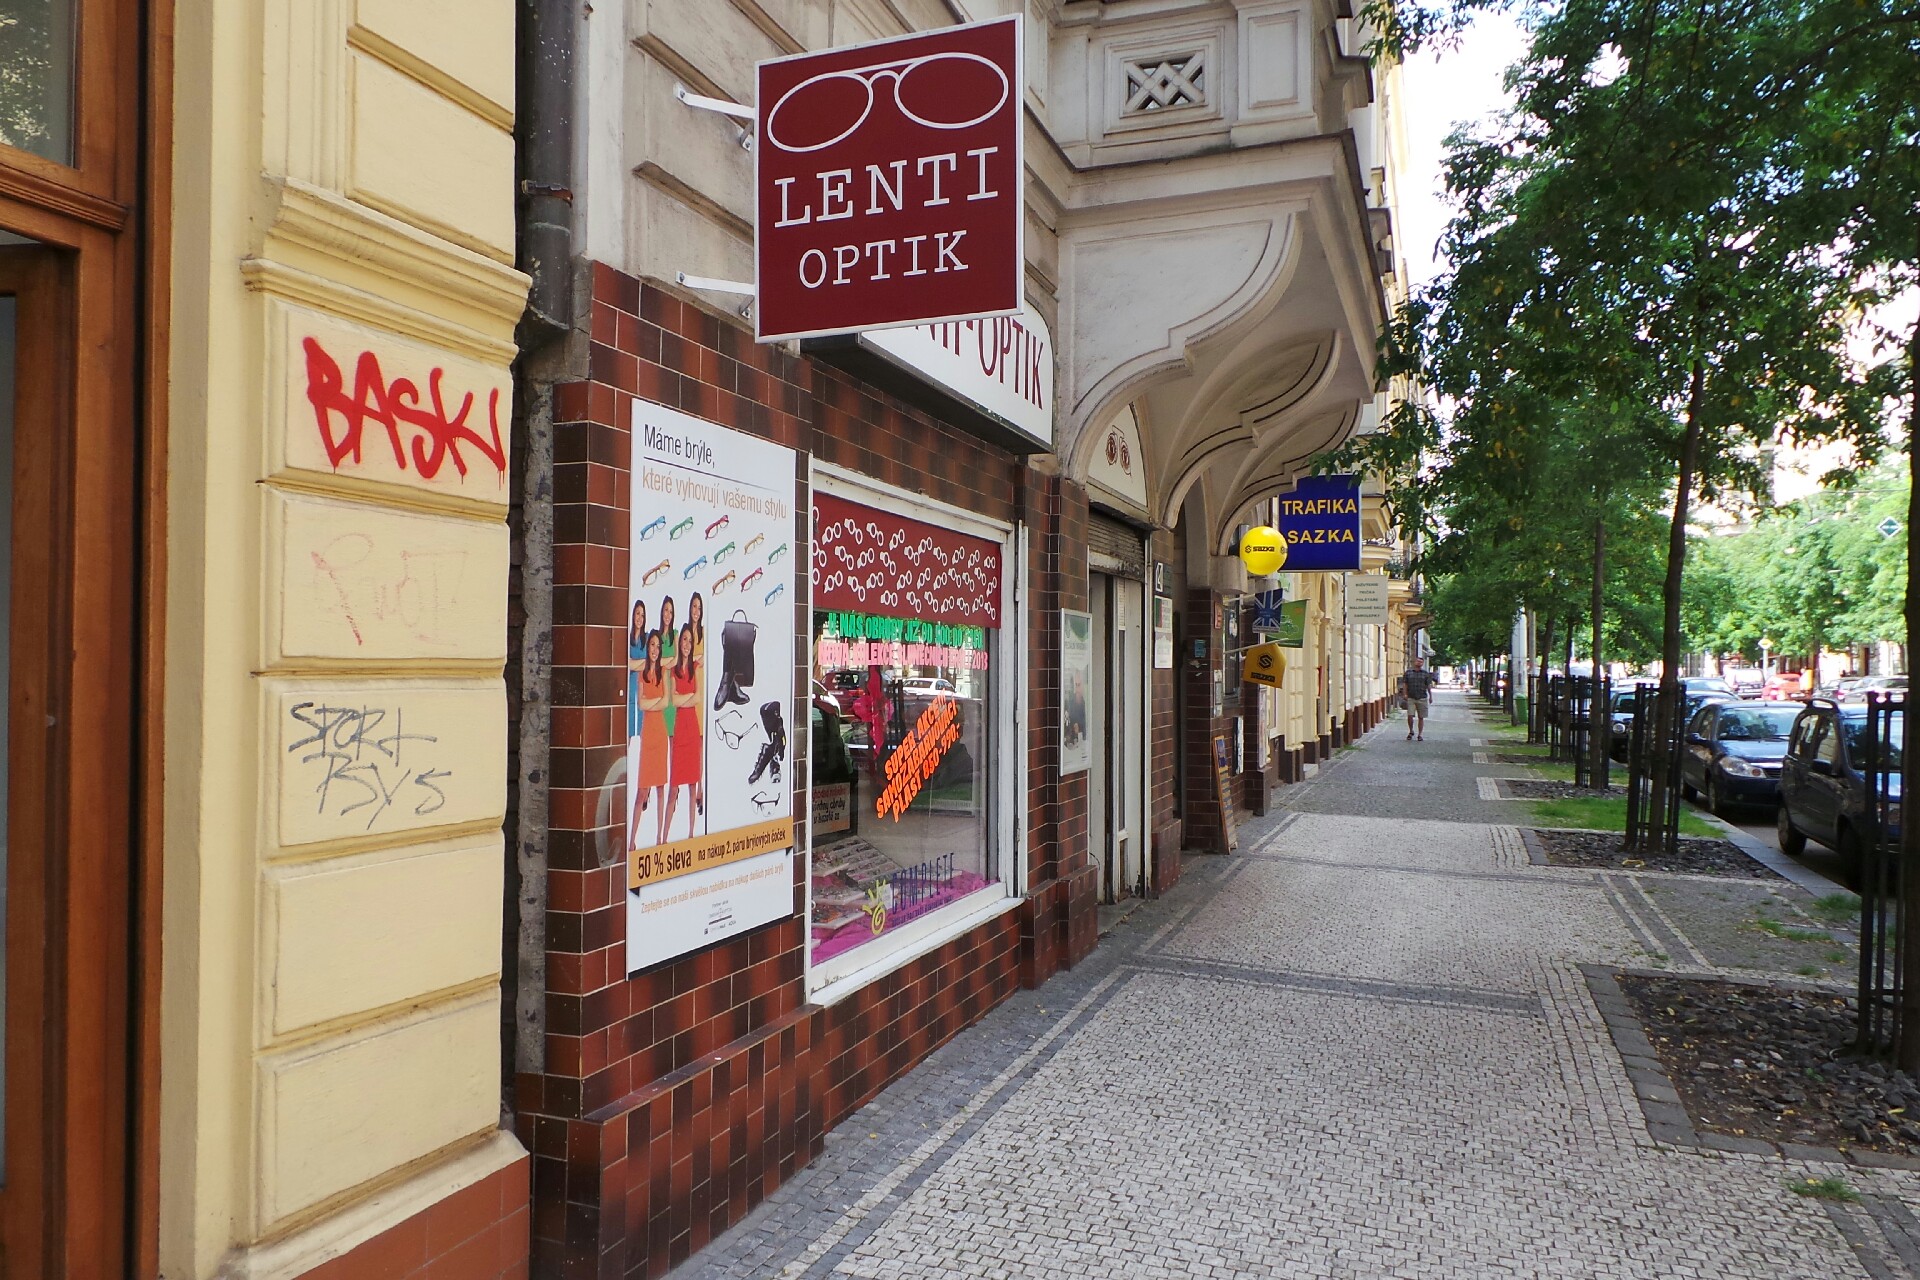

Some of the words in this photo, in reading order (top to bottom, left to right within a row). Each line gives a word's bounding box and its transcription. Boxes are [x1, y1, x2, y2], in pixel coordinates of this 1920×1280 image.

[774, 146, 998, 228] LENTI
[799, 230, 969, 289] OPTIK
[643, 423, 682, 456] Máme
[685, 436, 715, 468] brýle,
[642, 465, 673, 494] které
[676, 476, 720, 508] vyhovují
[722, 488, 762, 514] vašemu
[764, 498, 787, 521] stylu
[1282, 498, 1357, 516] TRAFIKA
[1287, 529, 1355, 544] SAZKA
[828, 612, 837, 636] U
[840, 610, 864, 638] NÁS
[905, 617, 920, 642] JIŽ
[972, 650, 988, 671] 2013
[885, 730, 916, 781] SUPER
[892, 769, 922, 823] PLAST
[638, 854, 651, 880] 50
[654, 850, 664, 876] %
[666, 848, 692, 873] sleva
[697, 849, 706, 861] na
[706, 843, 726, 858] nákup
[726, 840, 732, 854] 2.
[732, 838, 745, 856] páru
[746, 831, 771, 851] brýlových
[771, 828, 786, 844] čoček
